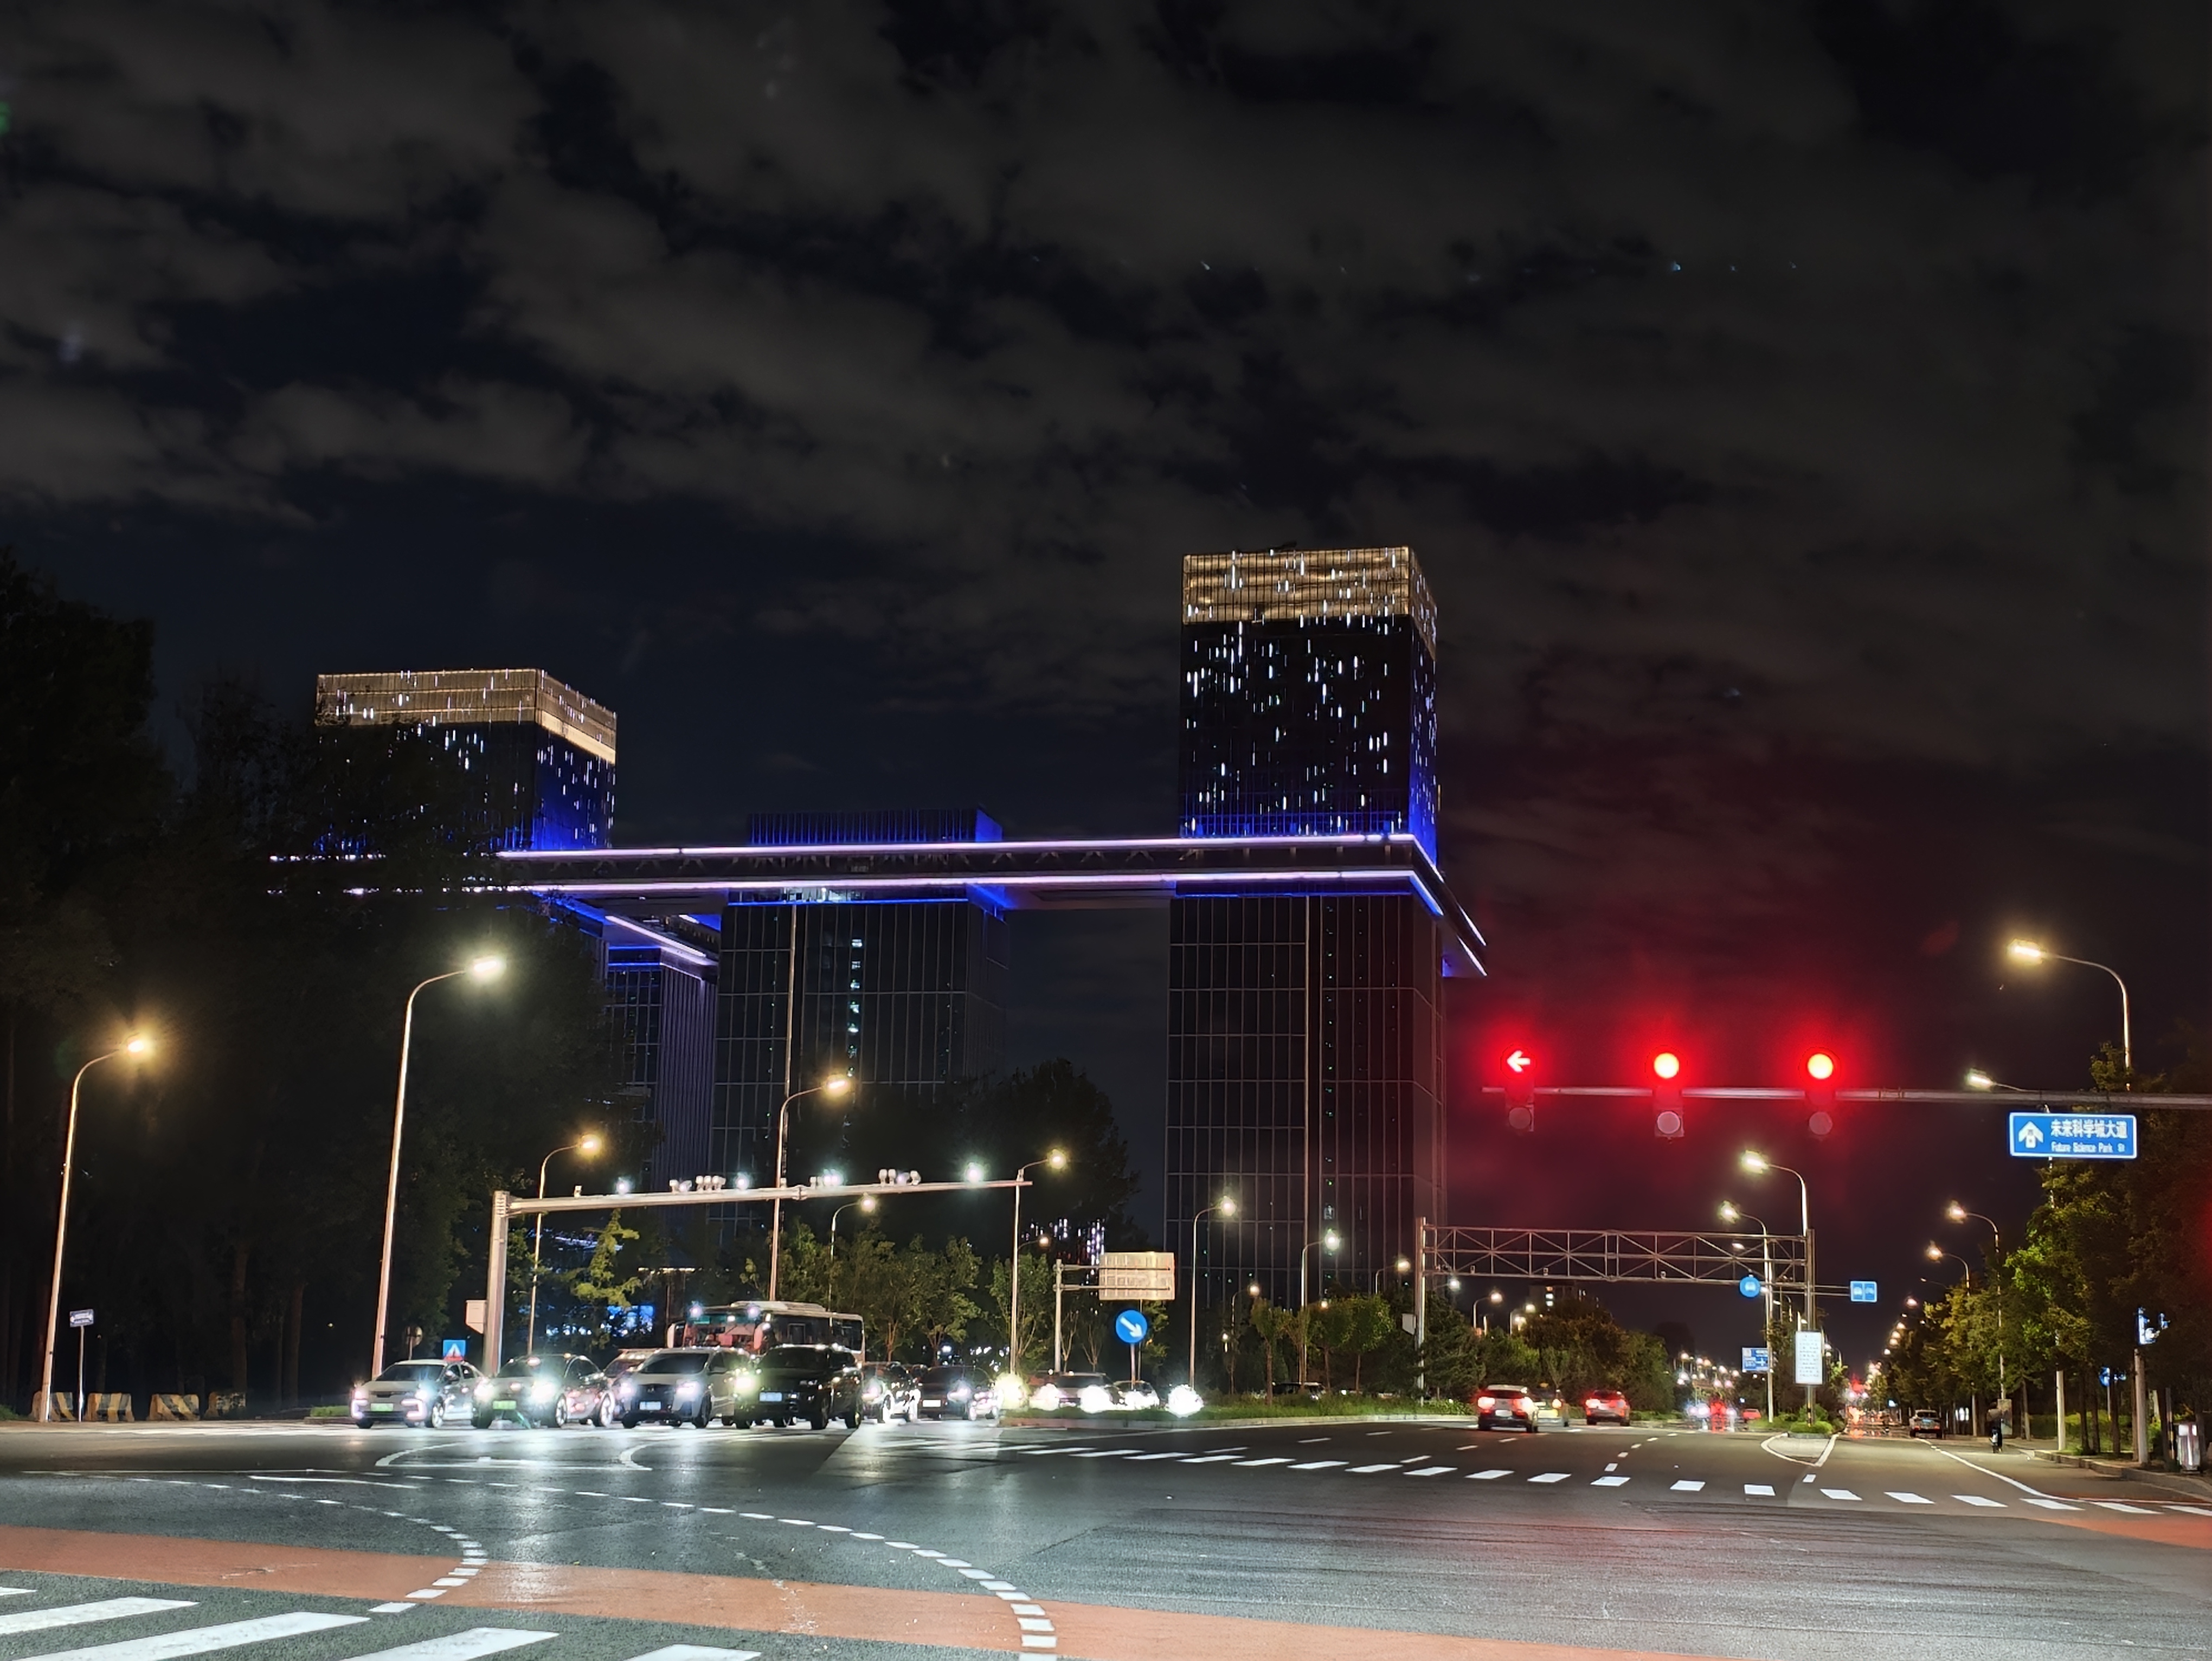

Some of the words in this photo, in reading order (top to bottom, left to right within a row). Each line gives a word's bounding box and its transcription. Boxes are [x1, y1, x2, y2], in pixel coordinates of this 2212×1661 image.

[2051, 1119, 2127, 1138] 未来科学城大道
[2051, 1141, 2071, 1153] Future
[2073, 1142, 2097, 1153] Science
[2099, 1142, 2113, 1153] Park
